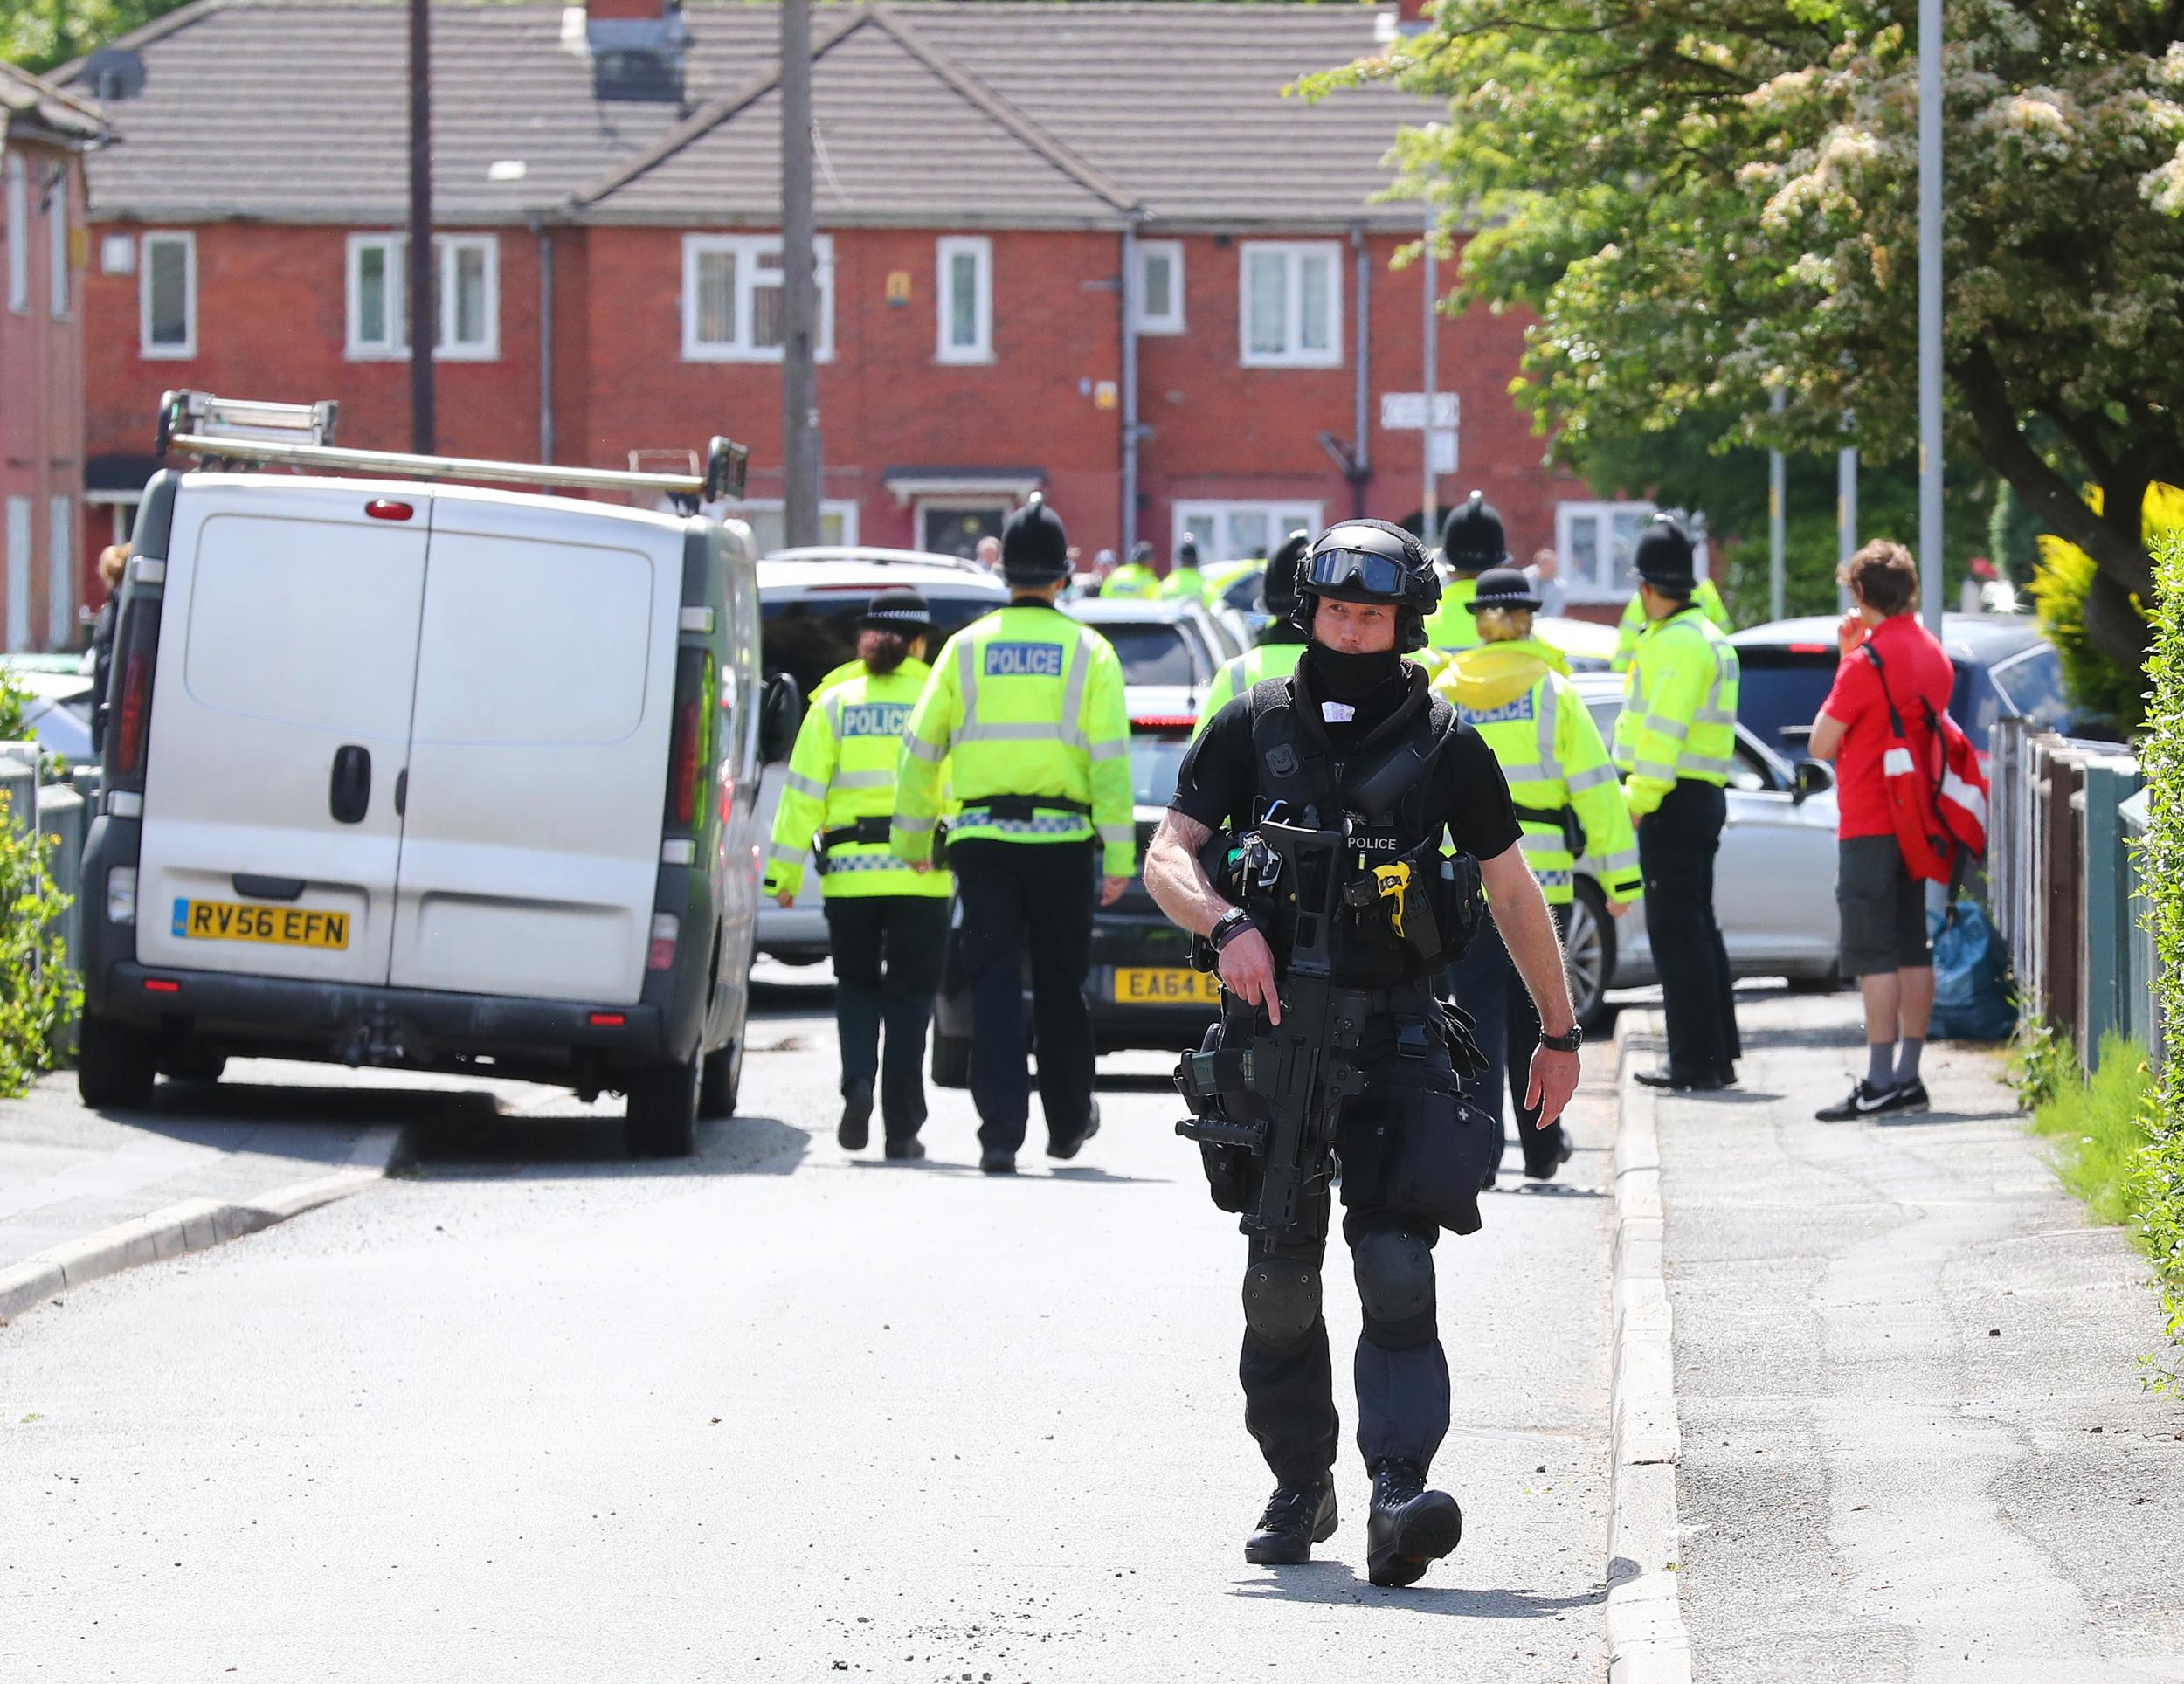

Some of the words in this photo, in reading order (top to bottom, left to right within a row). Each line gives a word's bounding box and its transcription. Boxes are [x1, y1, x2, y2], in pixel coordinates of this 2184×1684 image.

[986, 648, 1059, 673] POLICE
[1347, 837, 1397, 850] POLICE
[194, 905, 273, 936] RV56
[283, 912, 344, 944] EFN
[1130, 974, 1195, 996] EA64
